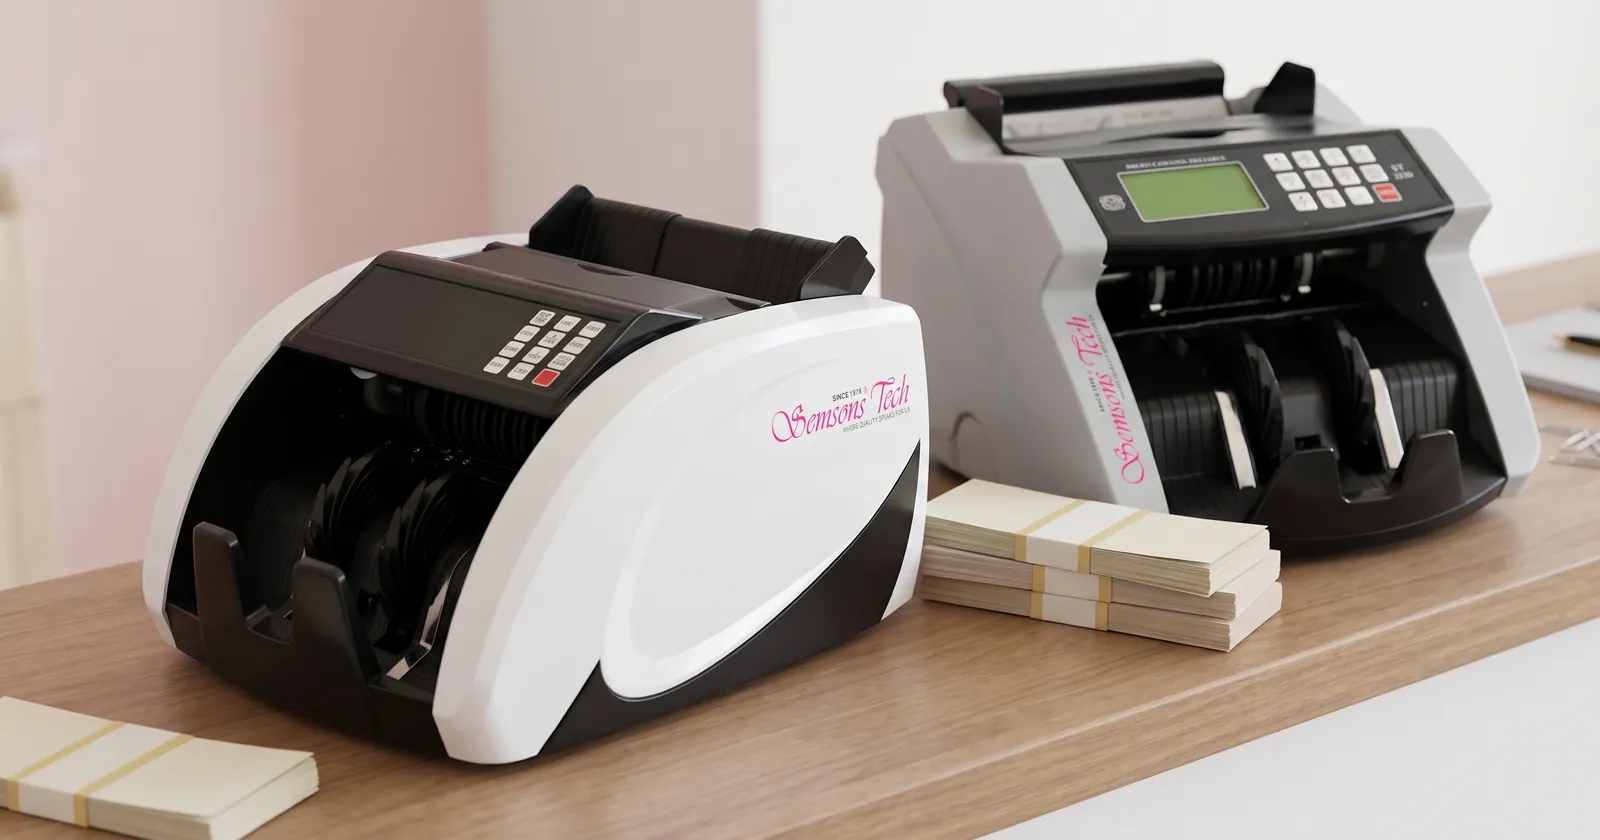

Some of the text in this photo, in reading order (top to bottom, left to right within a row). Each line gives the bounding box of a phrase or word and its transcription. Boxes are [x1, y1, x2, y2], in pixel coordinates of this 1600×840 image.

[1065, 316, 1103, 366] Tech
[771, 373, 910, 442] Semsons Tech
[832, 391, 849, 402] SINCE
[859, 417, 878, 428] QUALITY
[879, 411, 895, 422] SPEAKS
[895, 408, 904, 417] FOR
[1095, 371, 1145, 484] Semsons
